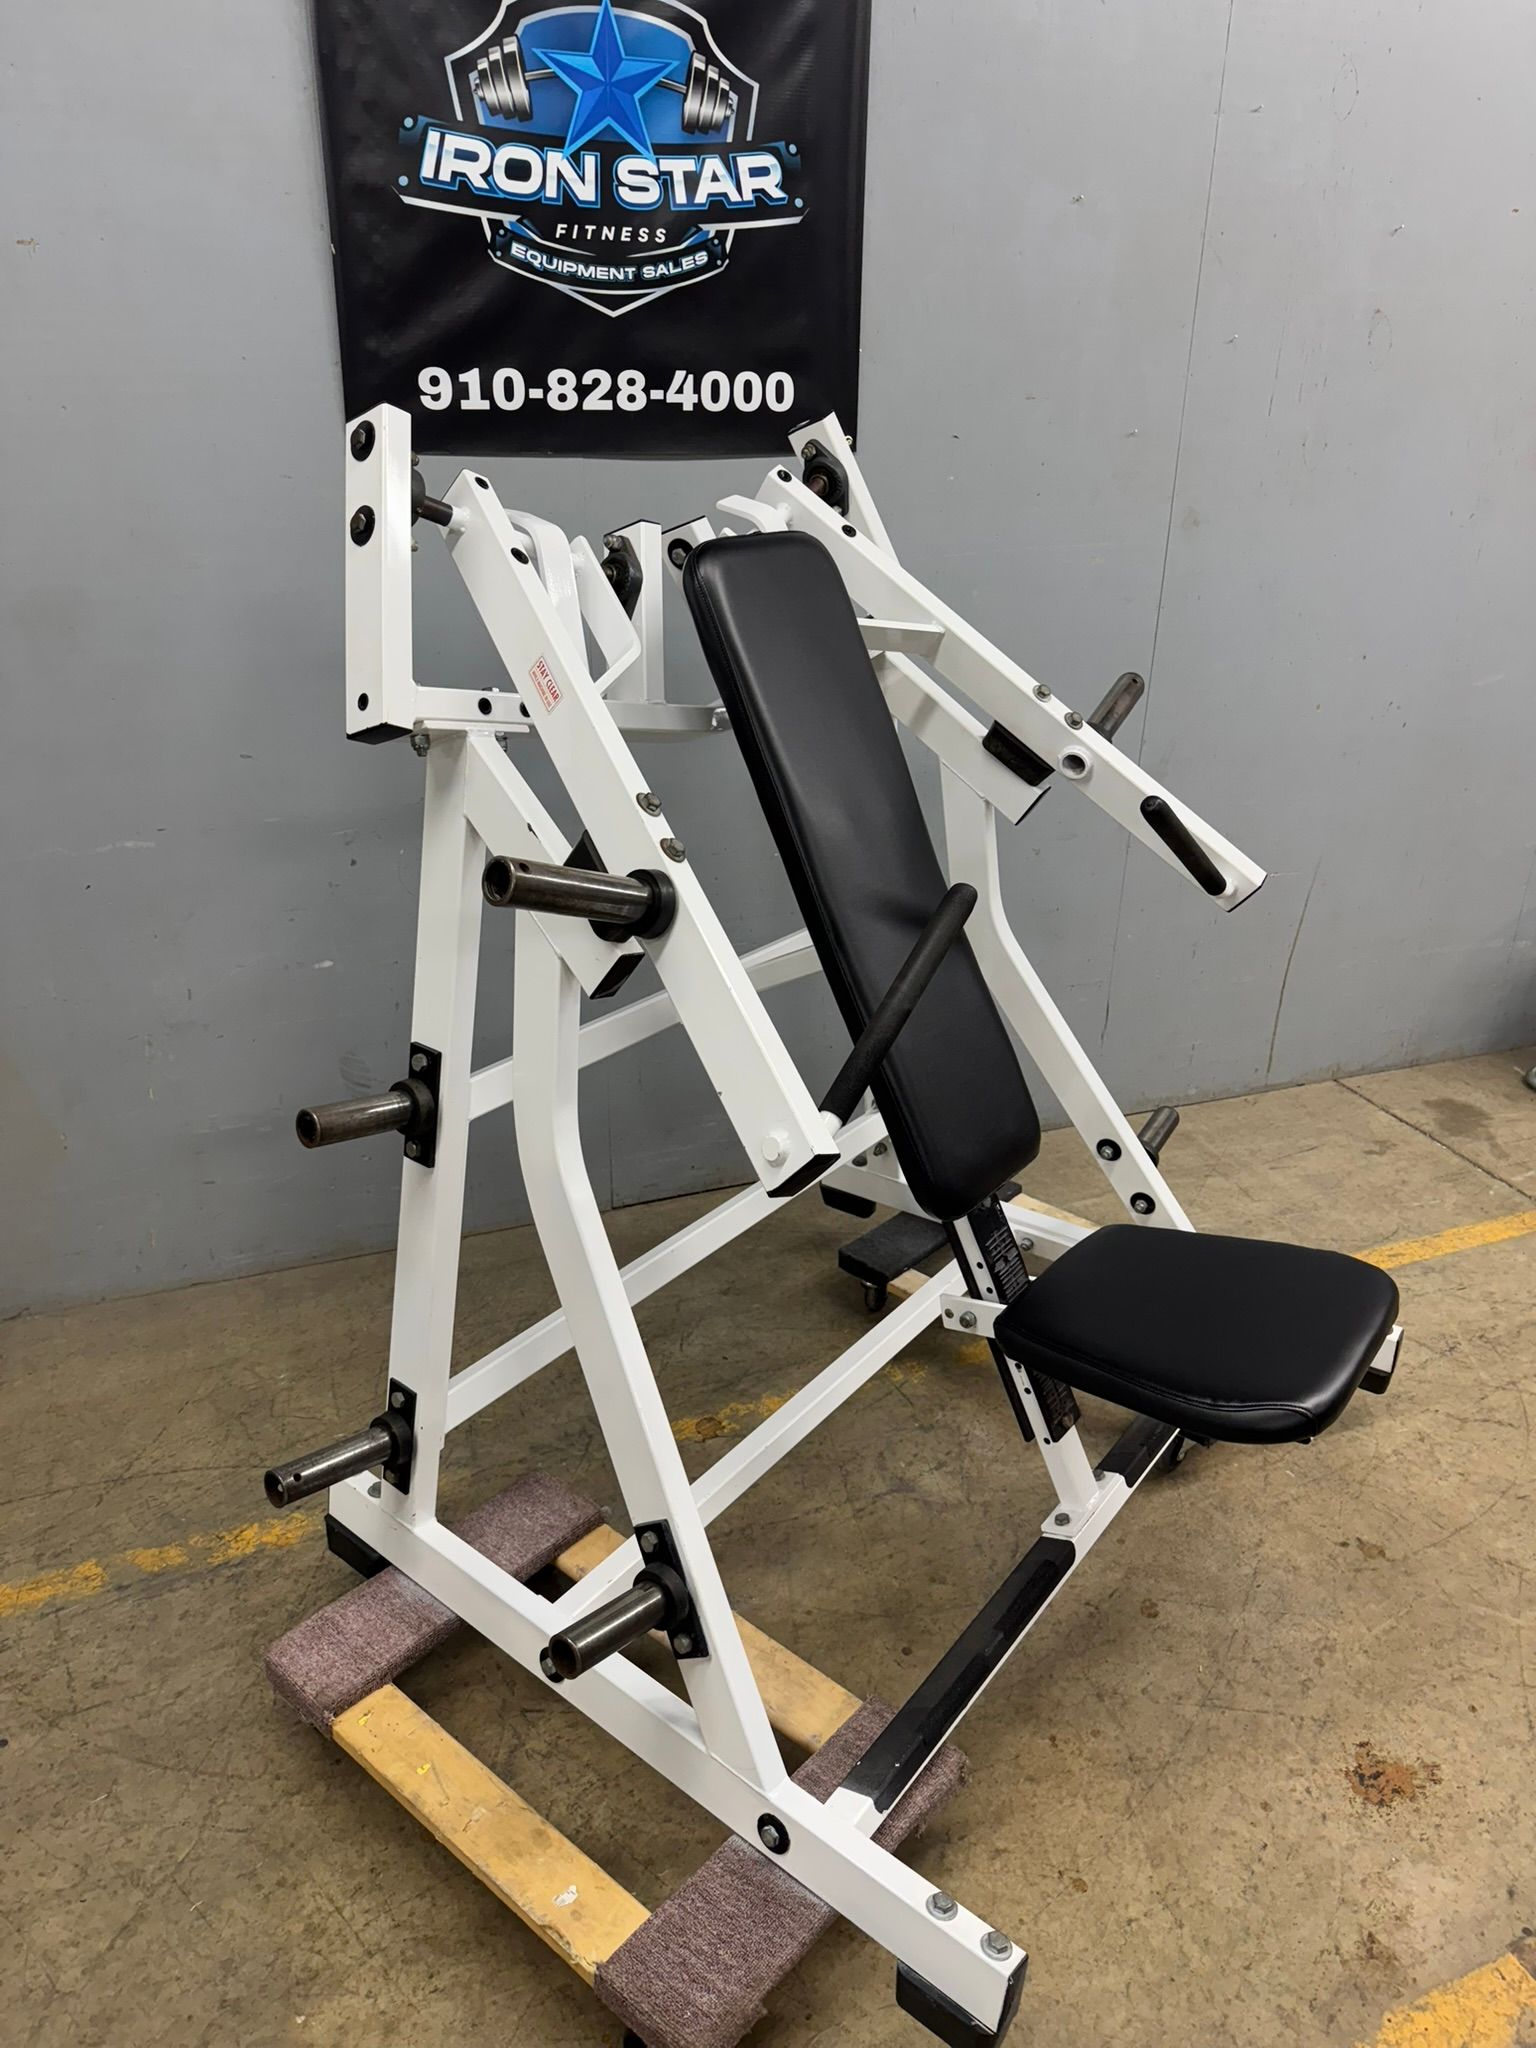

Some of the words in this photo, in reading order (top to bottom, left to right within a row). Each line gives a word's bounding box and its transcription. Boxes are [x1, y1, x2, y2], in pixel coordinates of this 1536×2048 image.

[420, 129, 598, 204] IRON
[615, 151, 788, 206] STAR
[555, 223, 667, 243] FITNESS
[510, 242, 636, 280] EQUIPMENT
[642, 251, 709, 279] SALES
[418, 367, 795, 412] 910-828-4000
[536, 660, 549, 680] STAY
[546, 679, 560, 702] CLEAR
